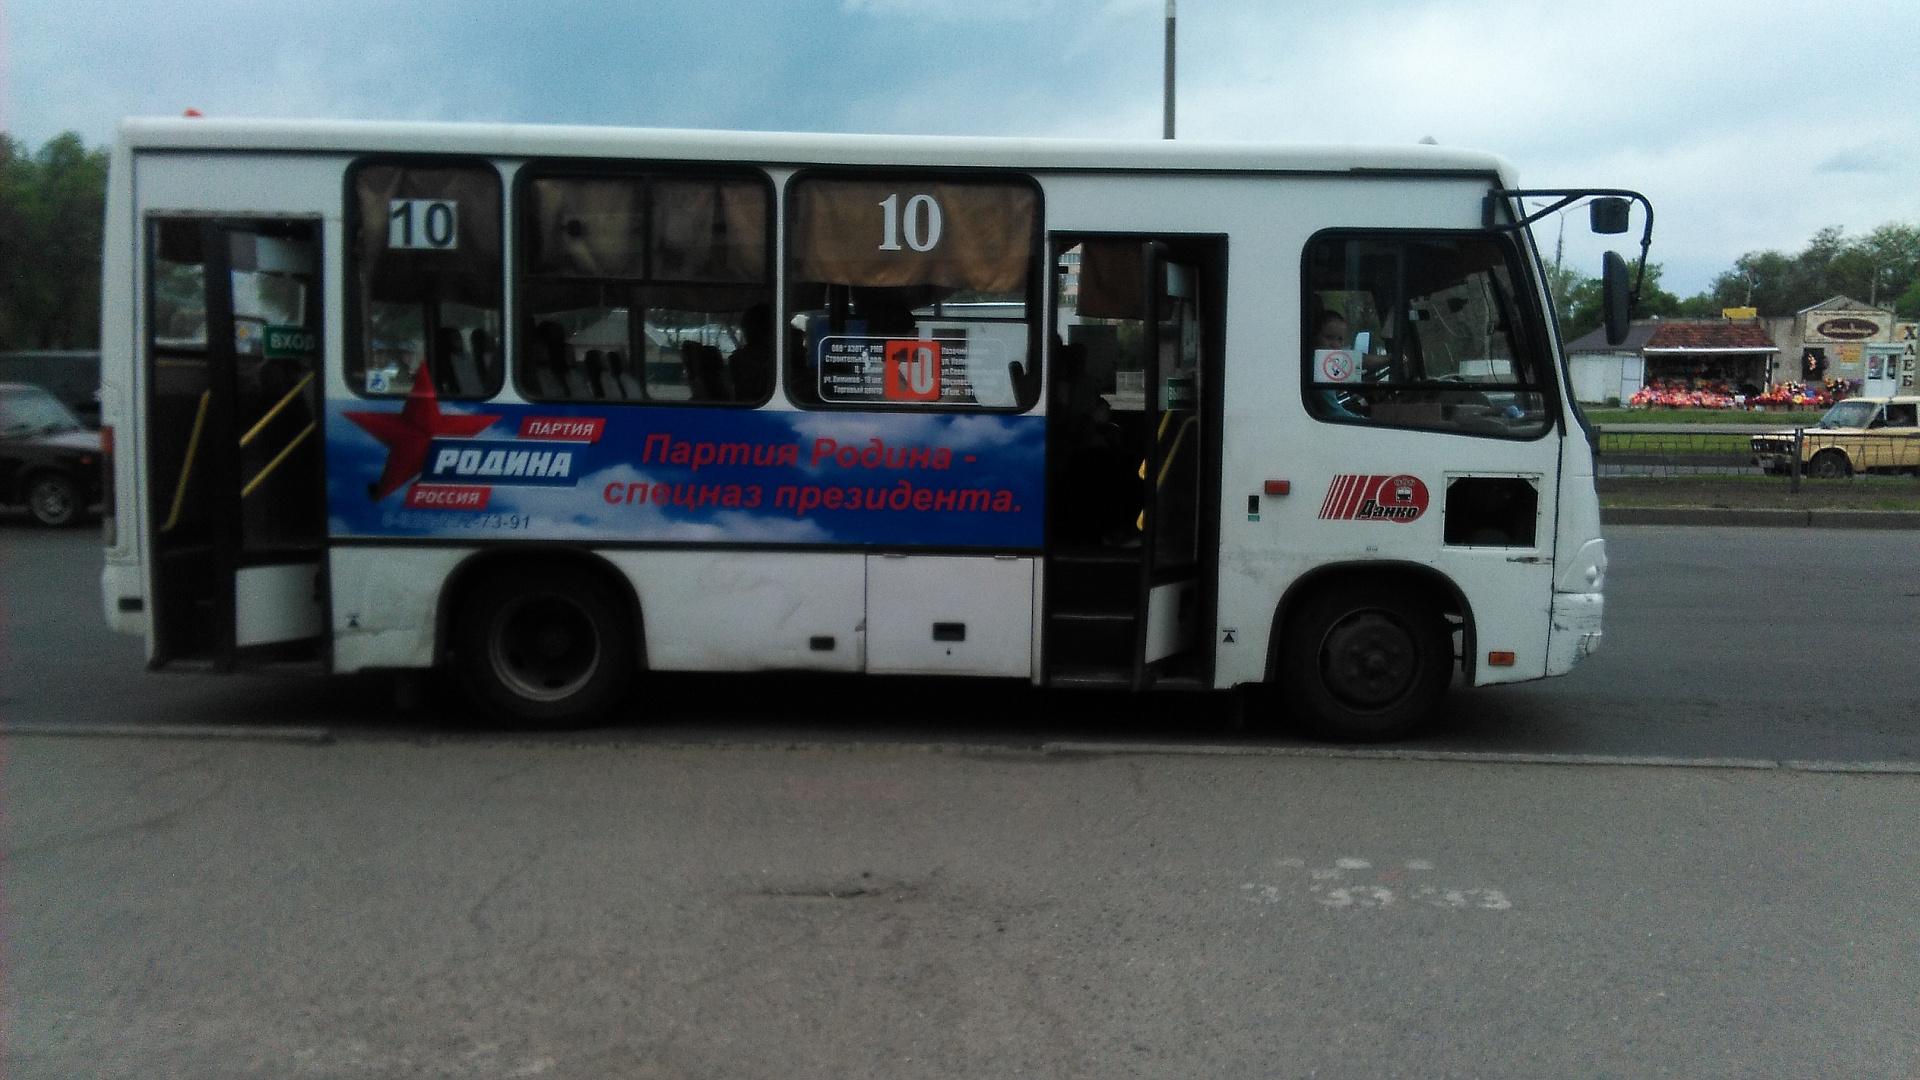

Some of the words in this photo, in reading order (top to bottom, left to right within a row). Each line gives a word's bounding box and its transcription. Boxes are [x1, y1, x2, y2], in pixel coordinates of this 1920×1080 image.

[390, 202, 453, 248] 10
[878, 193, 942, 252] 10
[891, 347, 934, 394] 10
[528, 421, 596, 436] ПАРТИЯ
[432, 448, 573, 478] РОДИНА
[642, 433, 799, 471] Партия
[810, 438, 953, 470] Родина
[413, 490, 481, 505] РОССИЯ
[603, 480, 762, 513] спецназ
[774, 481, 1022, 516] президента.
[1358, 499, 1419, 519] Данко
